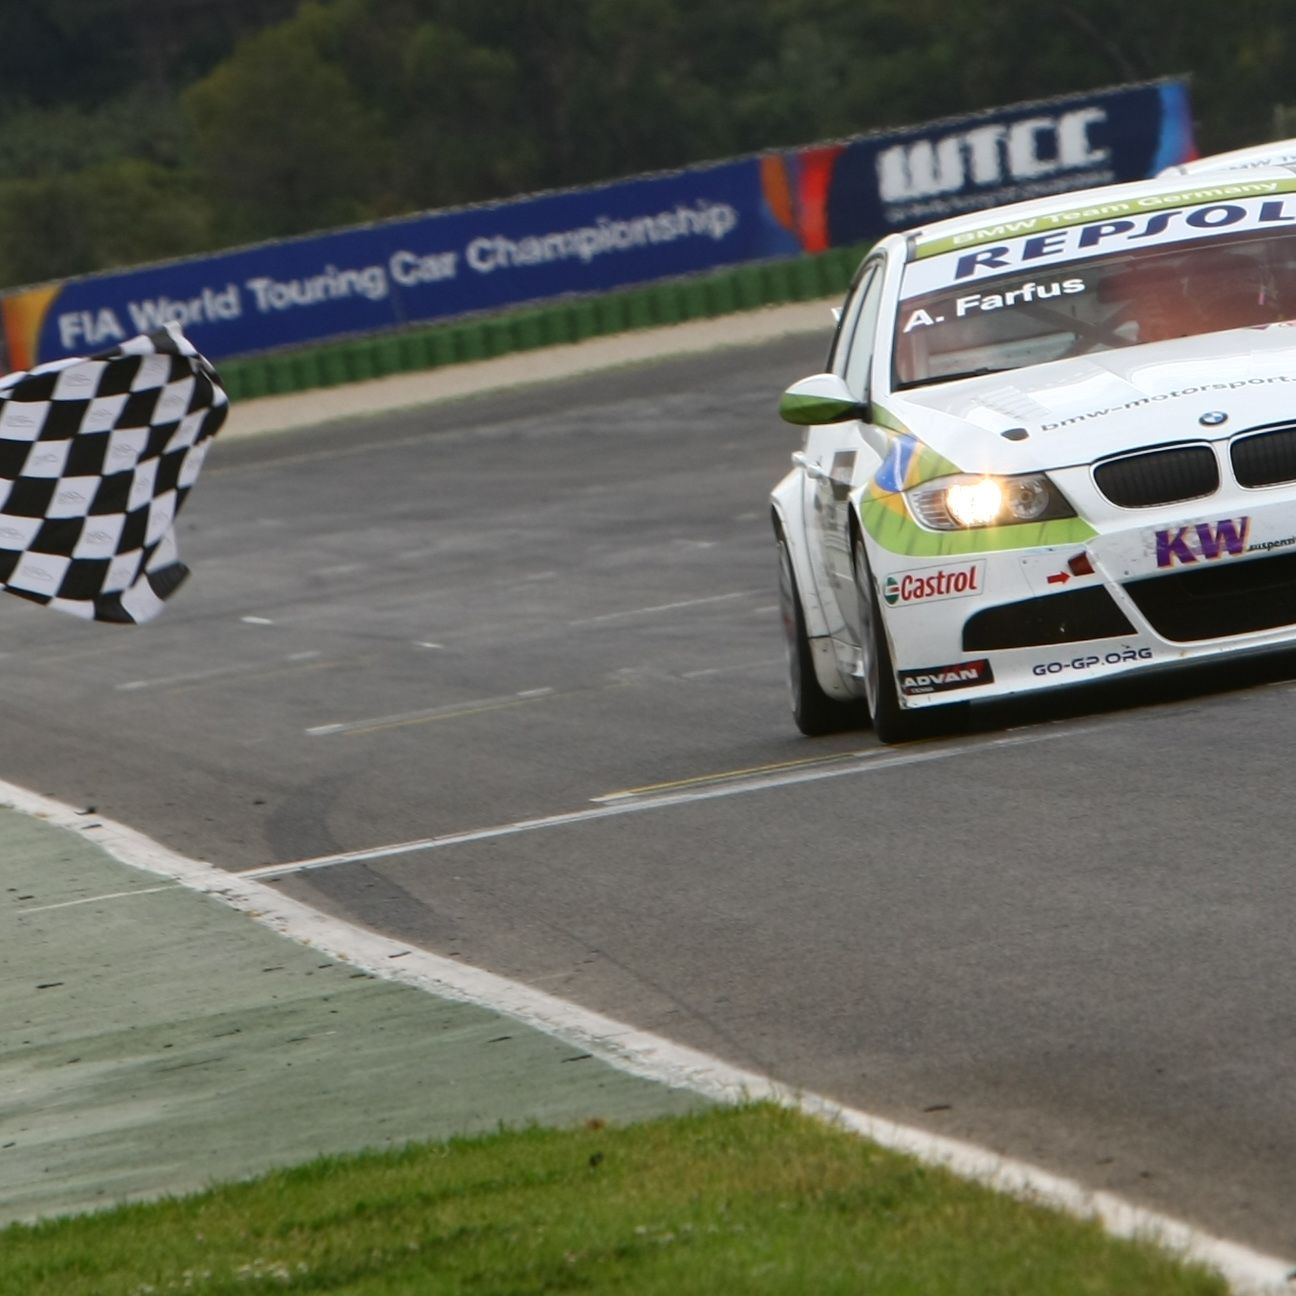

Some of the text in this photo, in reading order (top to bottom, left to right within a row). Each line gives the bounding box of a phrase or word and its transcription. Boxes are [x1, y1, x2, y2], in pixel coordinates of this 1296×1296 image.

[875, 106, 1109, 203] WTCC
[951, 214, 1041, 245] BMW
[1046, 201, 1128, 224] Team
[1135, 180, 1280, 208] Germany
[56, 198, 737, 350] FIA World Touring Car Championship
[903, 277, 1087, 334] A. Farfus
[1153, 516, 1251, 569] KW
[900, 566, 977, 601] Castrol
[903, 667, 980, 688] ADVAN
[1032, 647, 1153, 677] GO-GP.ORG
